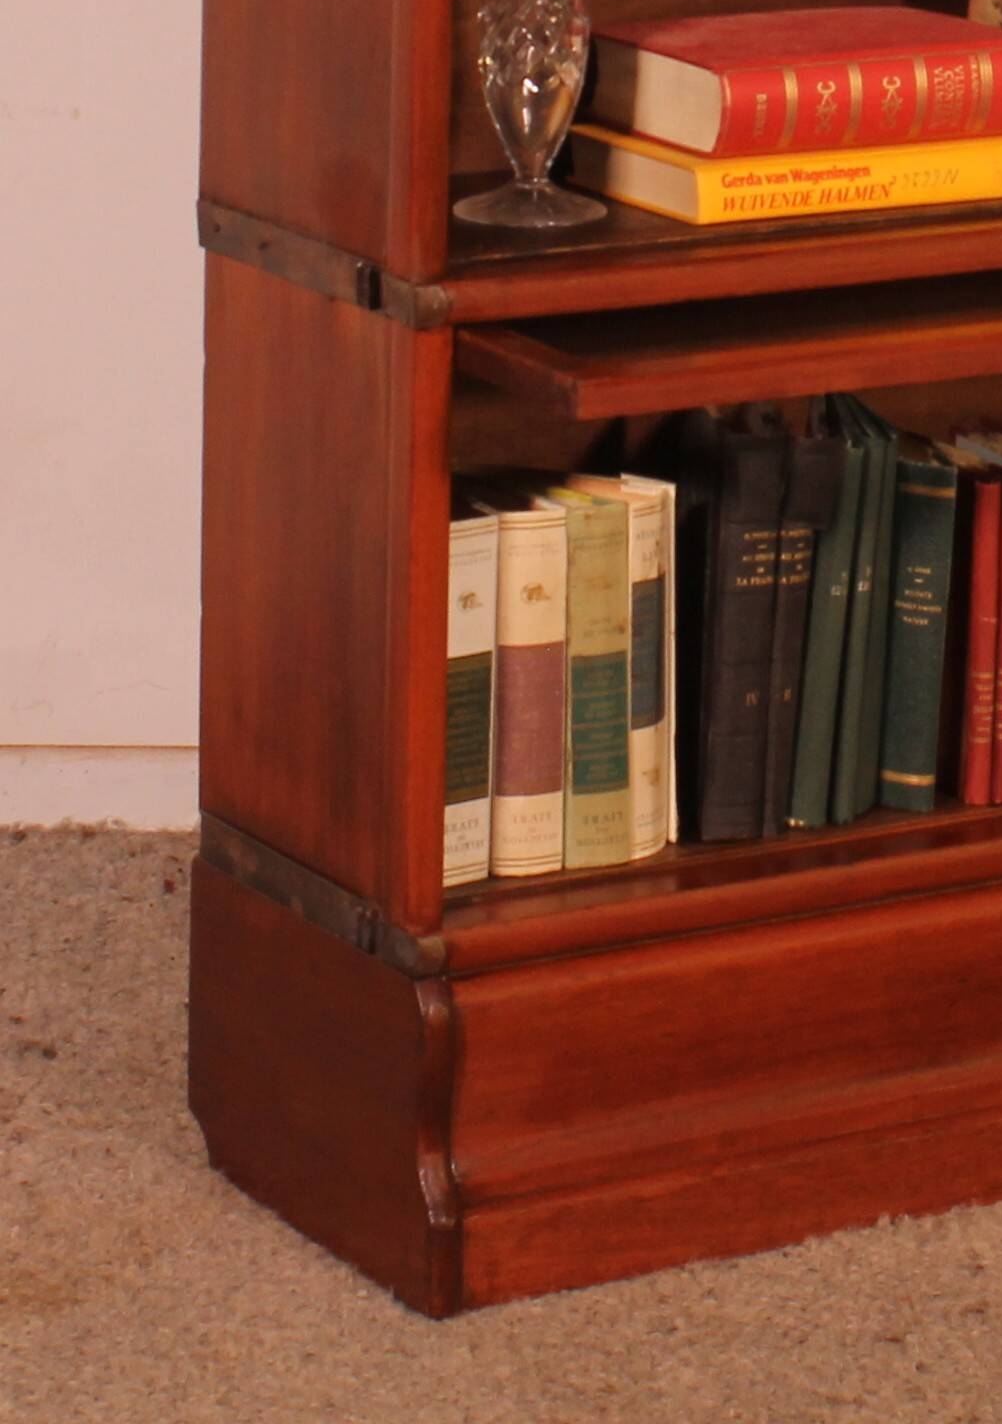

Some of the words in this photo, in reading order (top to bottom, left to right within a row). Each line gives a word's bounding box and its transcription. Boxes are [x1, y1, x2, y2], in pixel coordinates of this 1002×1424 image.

[721, 171, 763, 188] Gerda
[764, 172, 789, 185] van
[789, 164, 871, 186] Wageningen
[722, 188, 816, 213] WUIVENDE
[818, 183, 892, 207] HALMEN
